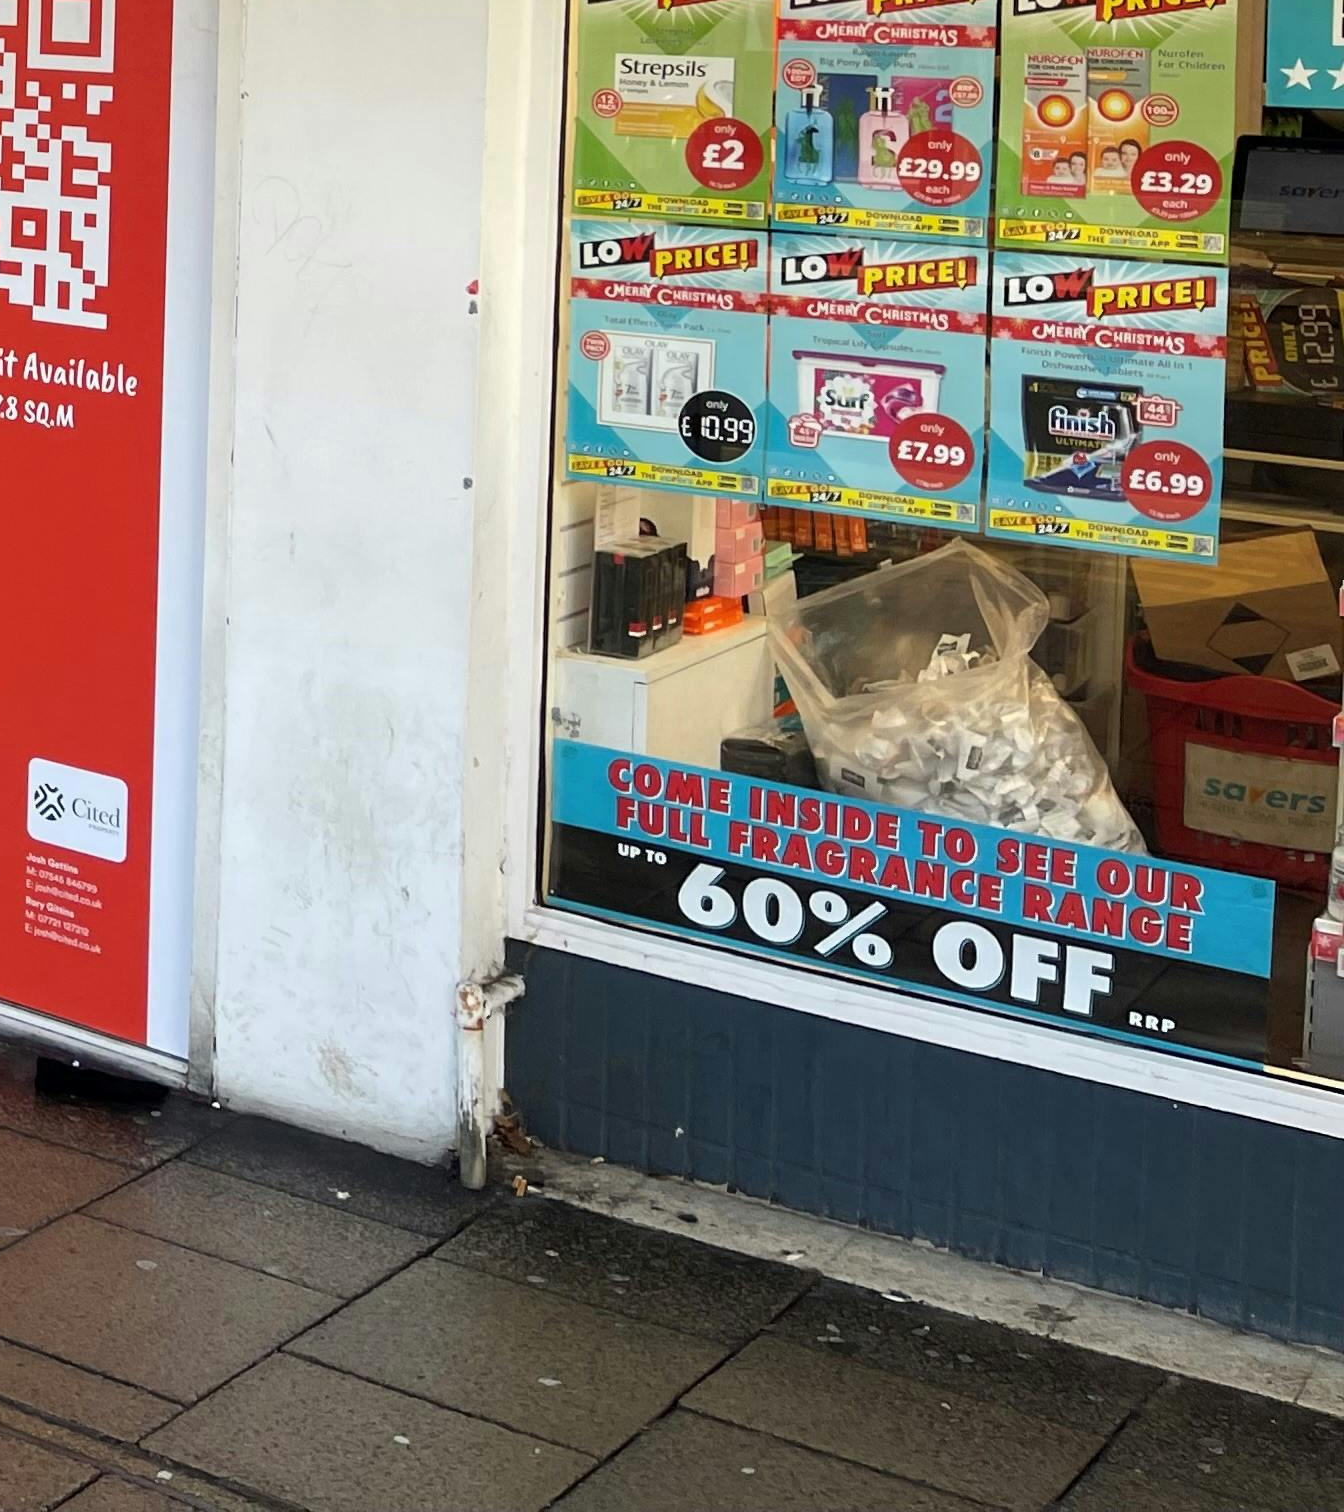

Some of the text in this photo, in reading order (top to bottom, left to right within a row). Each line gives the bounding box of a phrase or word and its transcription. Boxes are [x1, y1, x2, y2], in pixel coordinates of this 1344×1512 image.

[816, 22, 958, 46] MERRY CHRISTMAS
[1028, 55, 1084, 65] NUROFEN
[1087, 49, 1143, 58] NUROFEN
[1158, 49, 1204, 58] Nurofen
[620, 58, 707, 80] Strepsils
[1158, 61, 1226, 71] For Children
[619, 78, 689, 88] Honey Lemon
[714, 125, 737, 136] only
[702, 139, 745, 170] £2
[928, 141, 953, 152] only
[1164, 152, 1191, 165] only
[898, 158, 980, 181] £29.99
[926, 185, 951, 195] each
[1140, 170, 1212, 195] £3.29
[1162, 199, 1188, 209] each
[583, 232, 749, 279] LOW PRICE!
[785, 249, 967, 297] LOW PRICE!
[604, 284, 734, 311] MERRY CHRISTMAS
[1008, 268, 1206, 320] LOW PRICE!
[807, 300, 948, 330] MERRY CHRISTMAS
[1032, 323, 1185, 355] MERRY CHRISTMAS
[23, 352, 138, 397] Available
[706, 400, 729, 411] only
[825, 390, 869, 410] Surf
[23, 400, 74, 428] SQ.M
[1048, 405, 1114, 436] finish
[920, 424, 945, 435] only
[898, 441, 965, 466] £7.99
[1154, 451, 1180, 464] only
[1129, 470, 1204, 495] £6.99
[1203, 774, 1326, 814] savers
[72, 797, 120, 828] Cited
[606, 758, 1206, 916] COME INSIDE TO SEE OUR
[617, 843, 668, 866] UP TO
[615, 796, 1196, 954] FULL FRAGRANCE RANGE
[676, 862, 1176, 1034] 60% OFF RRP
